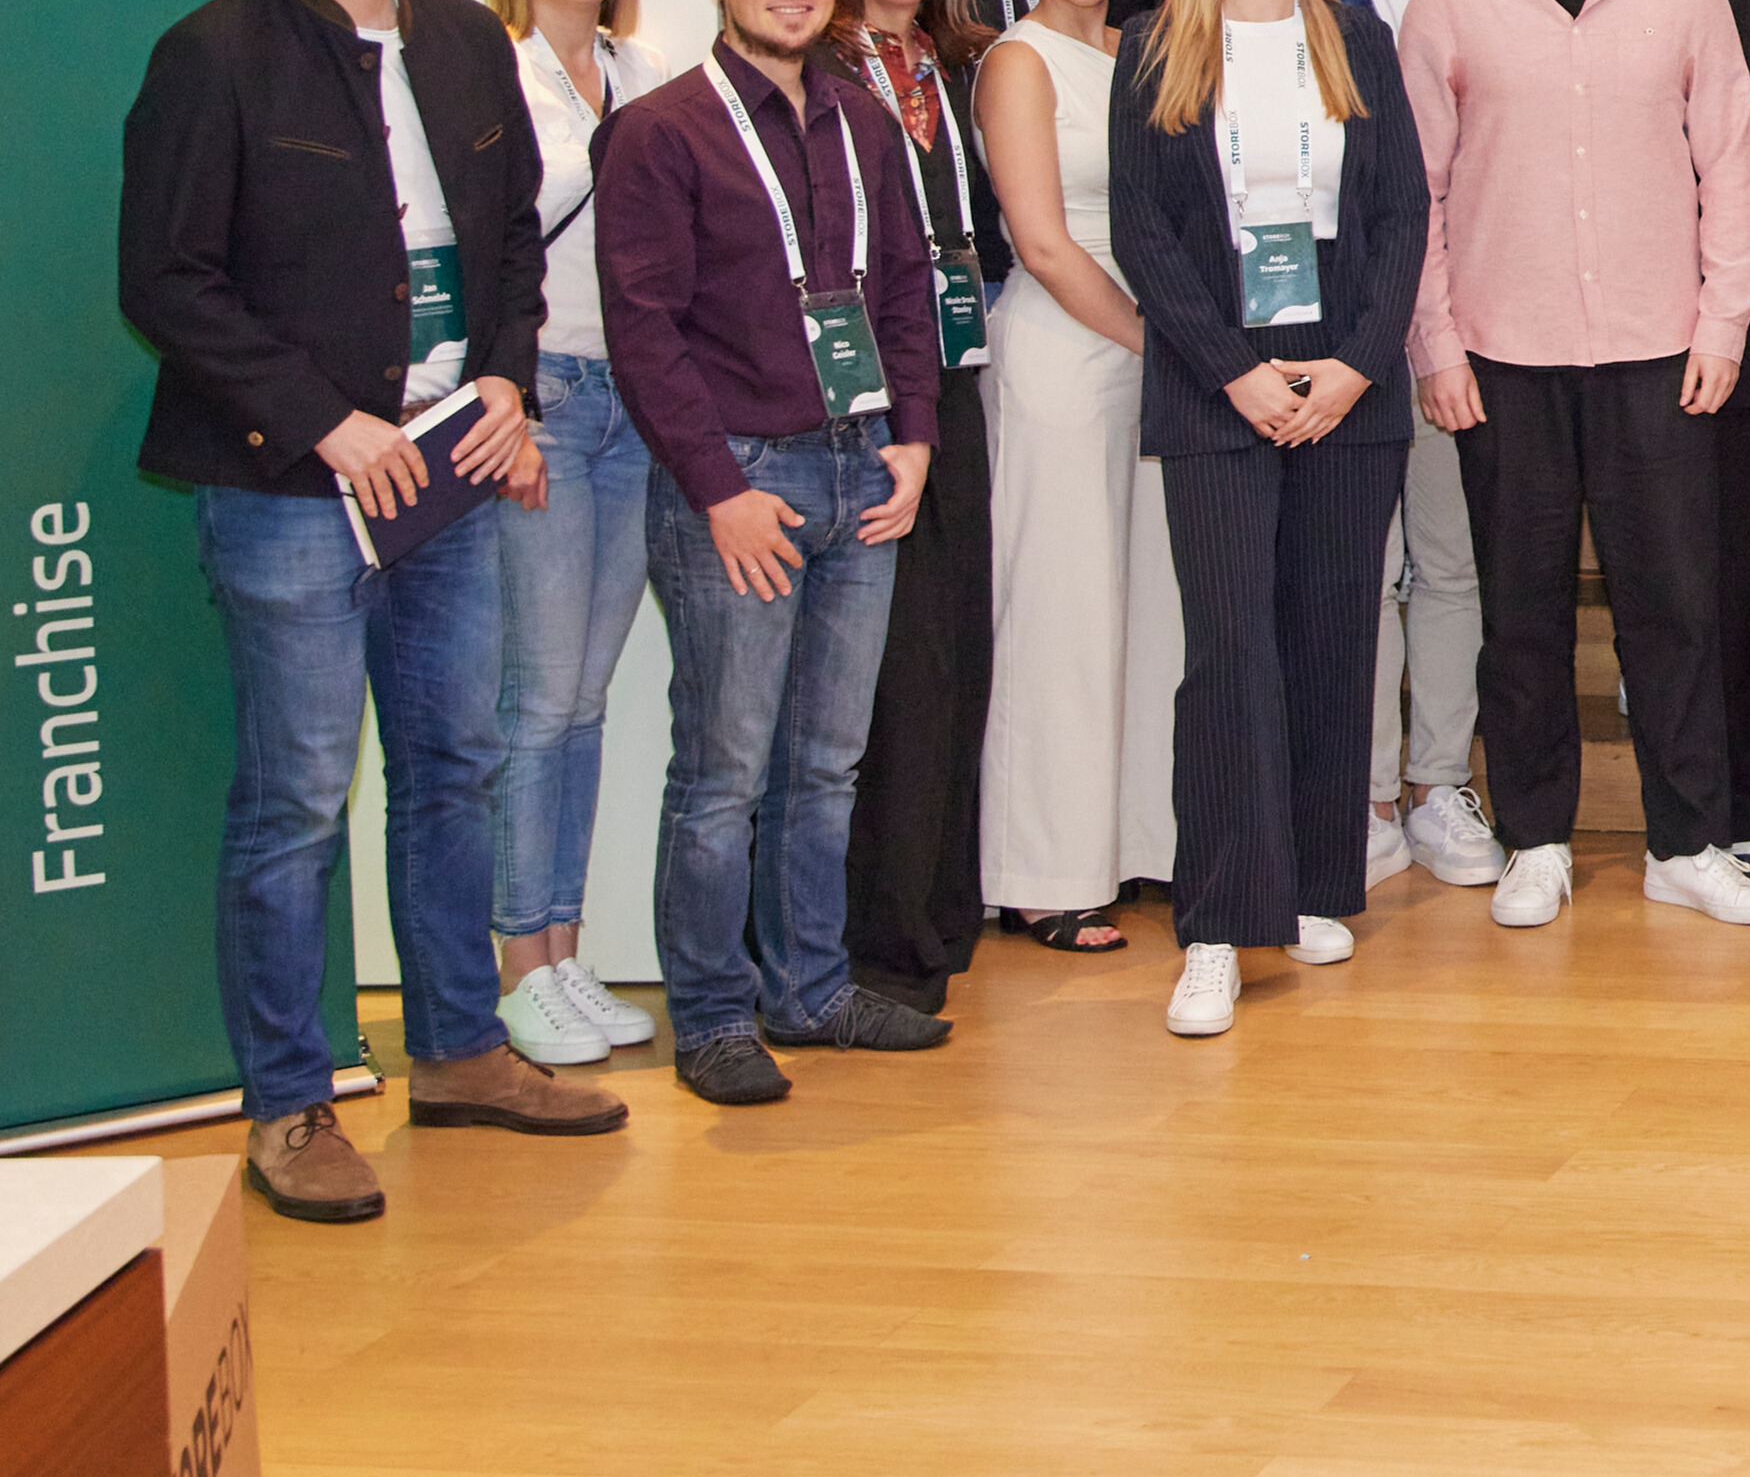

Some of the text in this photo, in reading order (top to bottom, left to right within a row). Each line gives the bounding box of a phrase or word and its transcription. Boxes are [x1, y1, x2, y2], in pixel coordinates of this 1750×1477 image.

[1296, 41, 1308, 90] STOREBOX
[714, 76, 752, 133] STOREBOX
[1229, 109, 1242, 166] STOREBOX
[1299, 122, 1310, 179] STOREBOX
[954, 143, 967, 203] STOREBOX
[769, 184, 796, 247] STOREBOX
[852, 176, 867, 238] STOREBOX
[1259, 263, 1300, 275] Tromayer
[1268, 254, 1289, 265] Anja
[13, 502, 106, 893] Franchise
